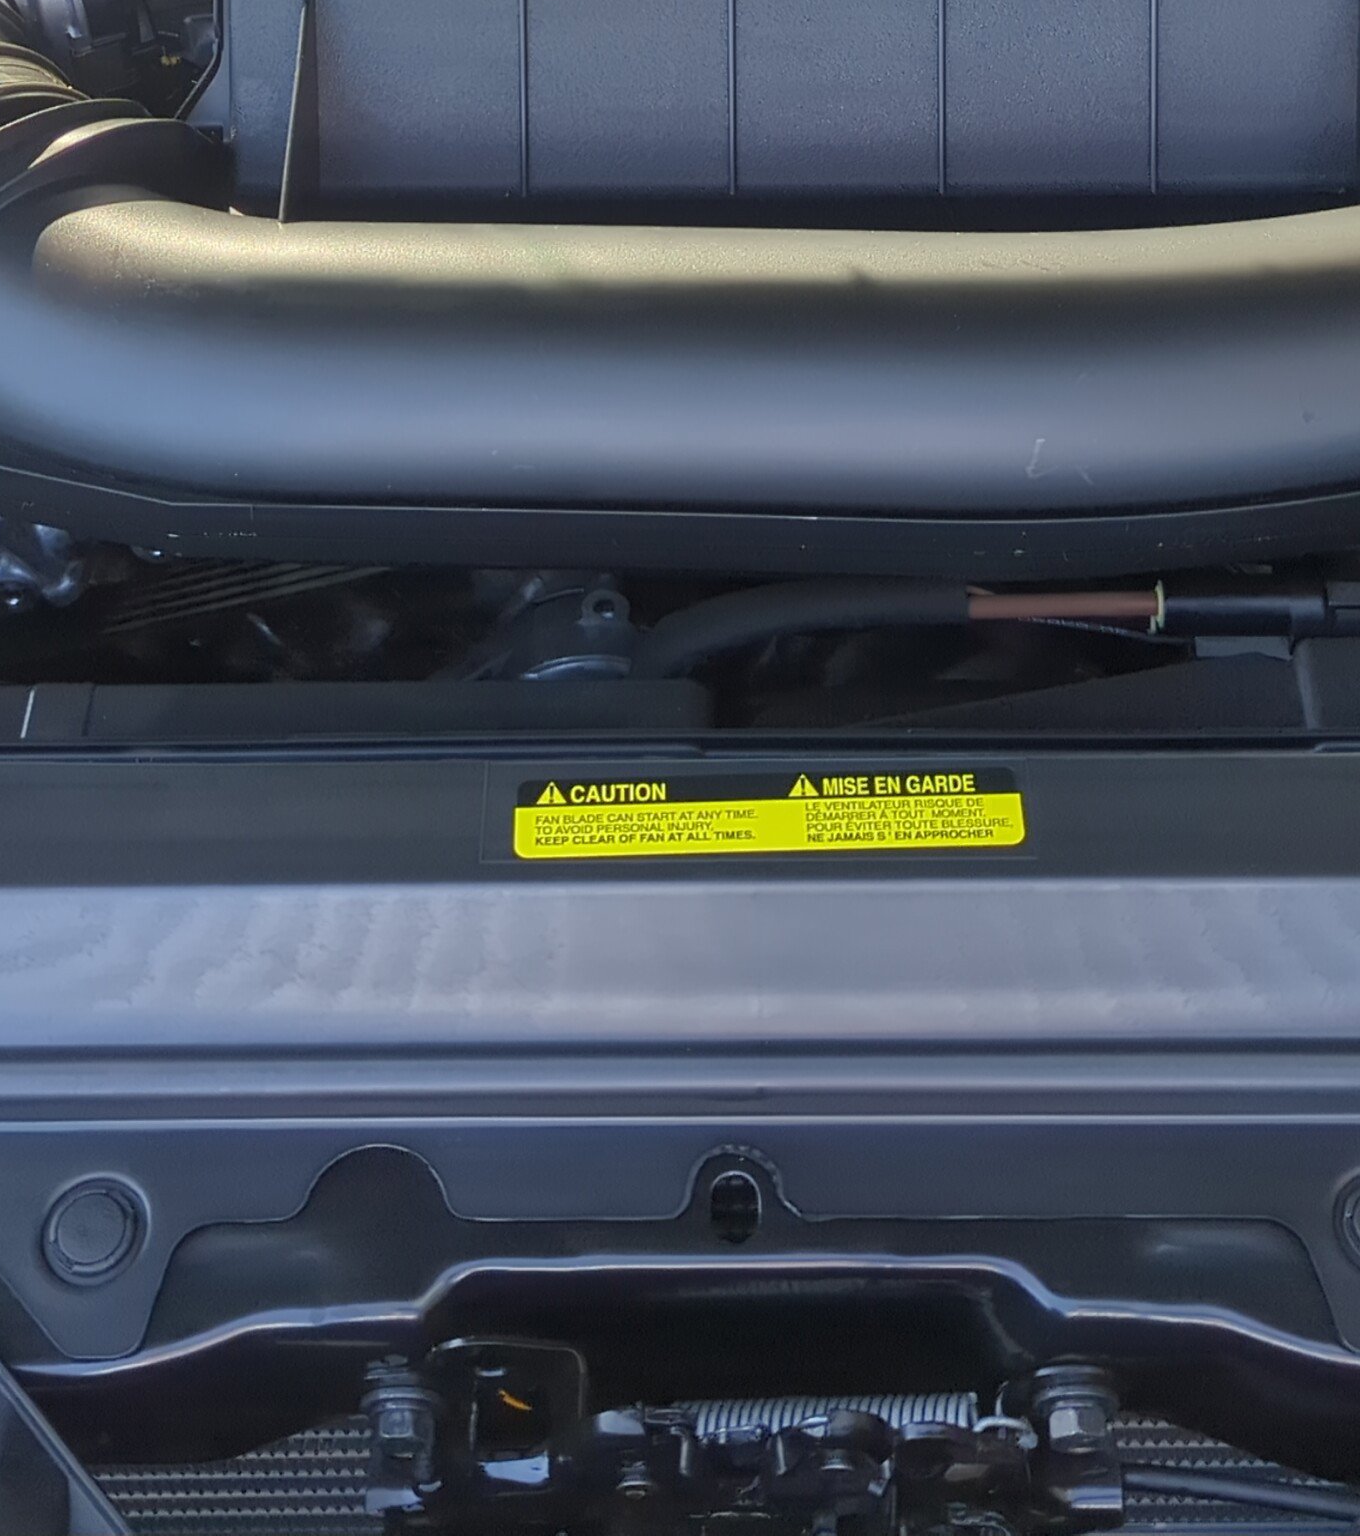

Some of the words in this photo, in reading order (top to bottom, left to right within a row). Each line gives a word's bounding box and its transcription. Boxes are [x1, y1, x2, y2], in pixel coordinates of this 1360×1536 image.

[822, 777, 869, 795] MISE
[874, 776, 901, 794] EN
[906, 774, 976, 794] GARDE
[570, 783, 666, 803] CAUTION
[805, 802, 820, 812] LE
[824, 799, 910, 811] VENTILATEUR
[914, 798, 962, 808] RISQUE
[966, 798, 984, 807] DE
[536, 815, 559, 824] FAN
[562, 814, 603, 824] BLADE
[607, 813, 634, 823] CAN
[637, 812, 676, 822] START
[678, 811, 694, 820] AT
[696, 810, 721, 820] ANY
[806, 810, 876, 822] DÉMARRER
[891, 809, 926, 819] TOUT
[536, 826, 554, 835] TO
[555, 825, 593, 834] AVOID
[597, 823, 664, 833] PERSONAL
[806, 822, 844, 832] POUR
[847, 820, 891, 831] ÉVITER
[893, 819, 936, 830] TOUTE
[535, 836, 569, 846] KEEP
[572, 834, 615, 844] CLEAR
[619, 834, 634, 843] OF
[640, 833, 665, 842] FAN
[668, 833, 685, 842] AT
[687, 832, 710, 841] ALL
[714, 831, 756, 840] TIMES.
[807, 833, 824, 843] NE
[827, 831, 874, 842] JAMAIS
[895, 831, 912, 840] EN
[914, 829, 993, 839] APPROCHER
